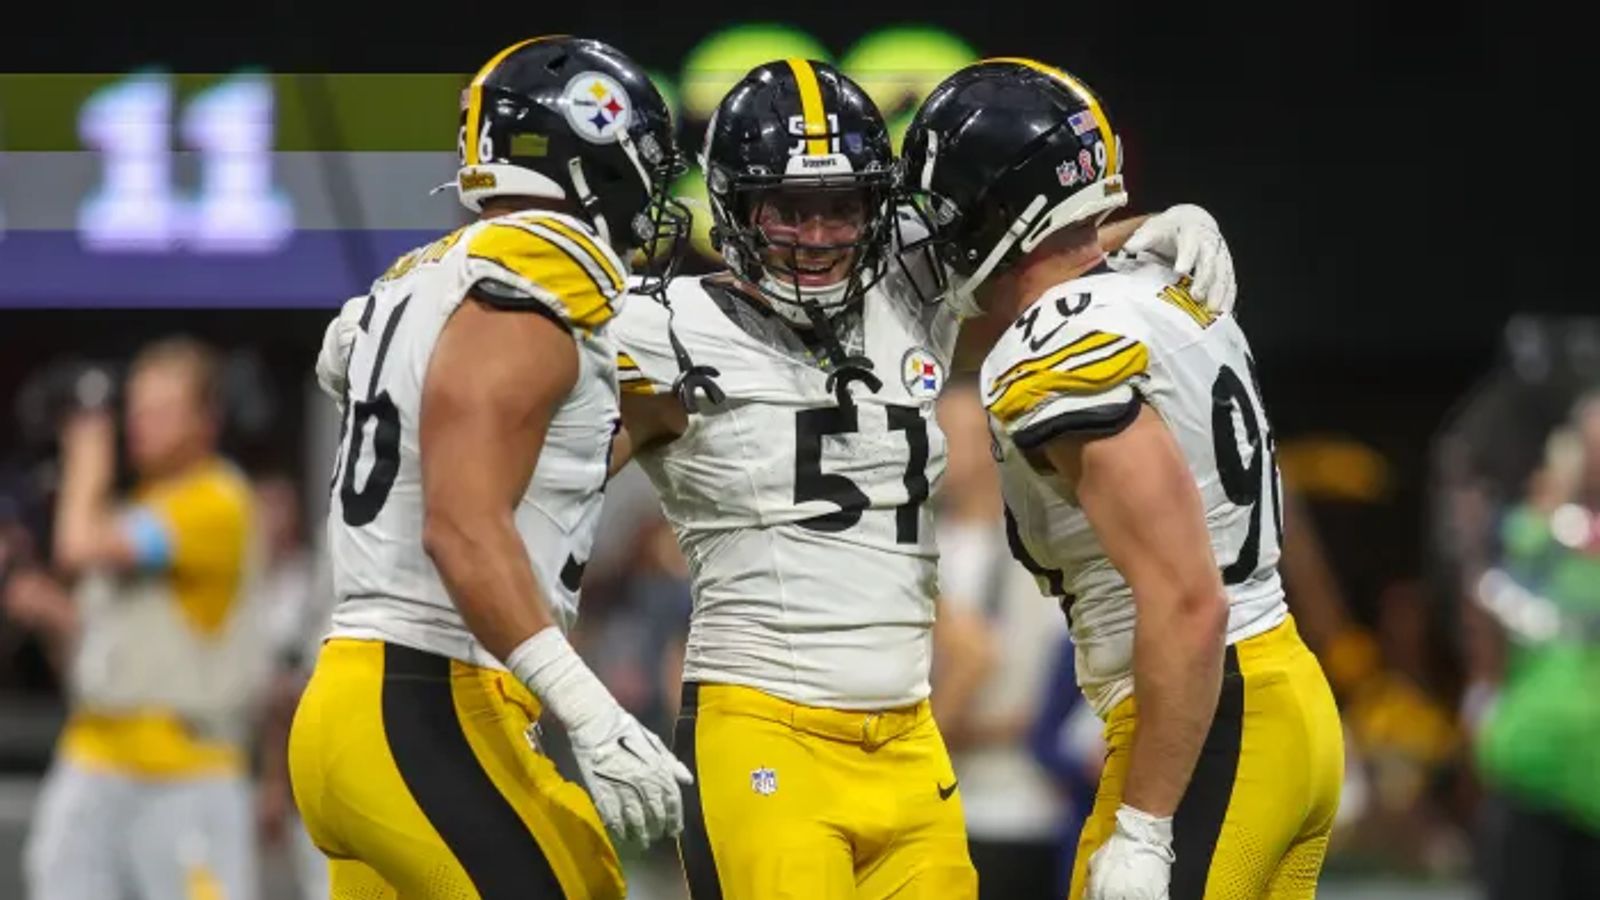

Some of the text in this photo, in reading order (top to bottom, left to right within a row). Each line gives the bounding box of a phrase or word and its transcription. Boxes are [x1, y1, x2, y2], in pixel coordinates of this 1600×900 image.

[77, 68, 293, 254] 11
[788, 114, 840, 155] 51
[794, 405, 929, 544] 51
